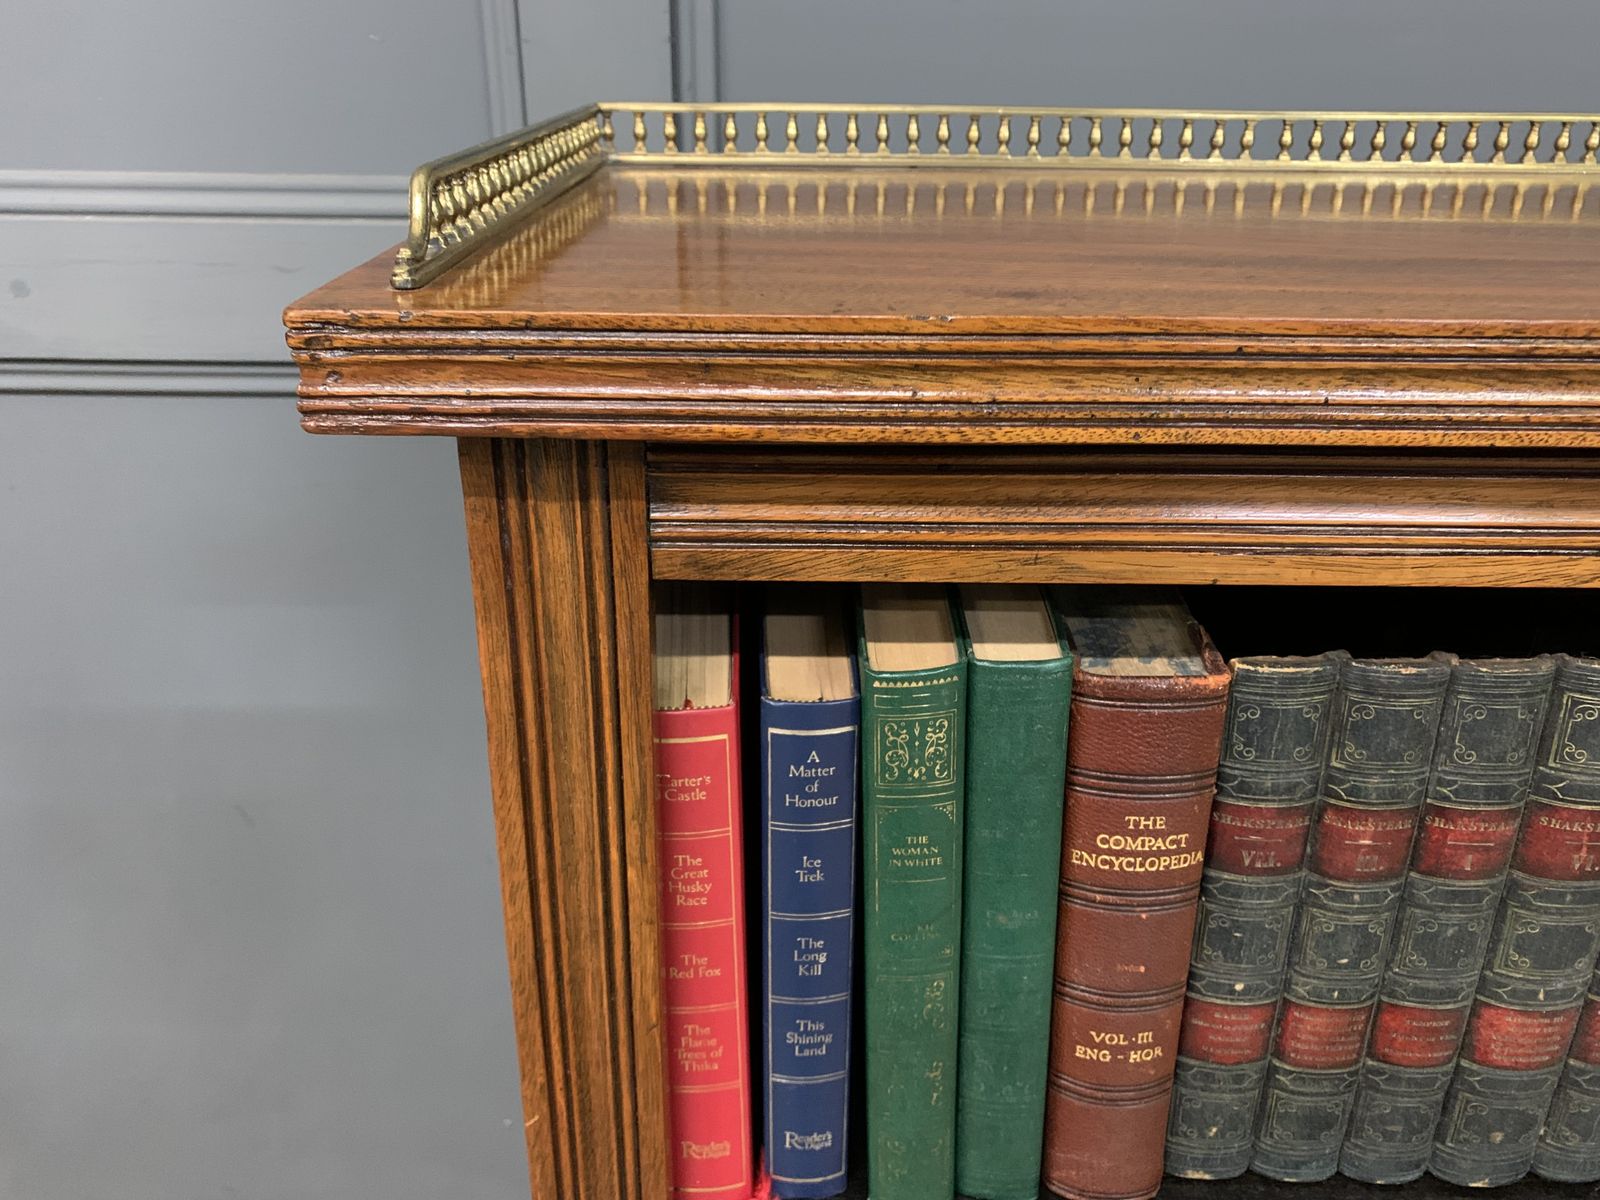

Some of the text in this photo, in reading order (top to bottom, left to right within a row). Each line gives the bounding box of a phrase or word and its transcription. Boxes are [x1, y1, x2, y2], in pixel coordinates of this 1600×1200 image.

[806, 751, 820, 763] A
[789, 765, 835, 778] Matter
[805, 780, 819, 793] of
[664, 788, 707, 801] Castle
[785, 795, 838, 807] Honour
[1125, 816, 1166, 830] THE
[905, 836, 929, 844] THE
[1097, 833, 1189, 851] COMPACT
[892, 847, 939, 856] WOMAN
[673, 855, 703, 867] The
[802, 856, 822, 868] Ice
[904, 857, 943, 867] WHITE
[1071, 849, 1204, 873] ENCYCLOPEDIA
[671, 867, 709, 880] Great
[795, 869, 825, 882] Trek
[668, 880, 712, 894] Husky
[676, 894, 708, 906] Race
[797, 937, 824, 949] The
[680, 955, 708, 966] The
[794, 950, 828, 962] Long
[670, 967, 721, 979] Red Fox
[799, 963, 822, 976] Kill
[683, 1023, 711, 1036] The
[796, 1020, 825, 1032] This
[785, 1032, 833, 1045] Shining
[710, 1045, 724, 1059] of
[794, 1045, 826, 1057] Land
[1075, 1045, 1112, 1063] ENG
[1128, 1047, 1163, 1063] HOR
